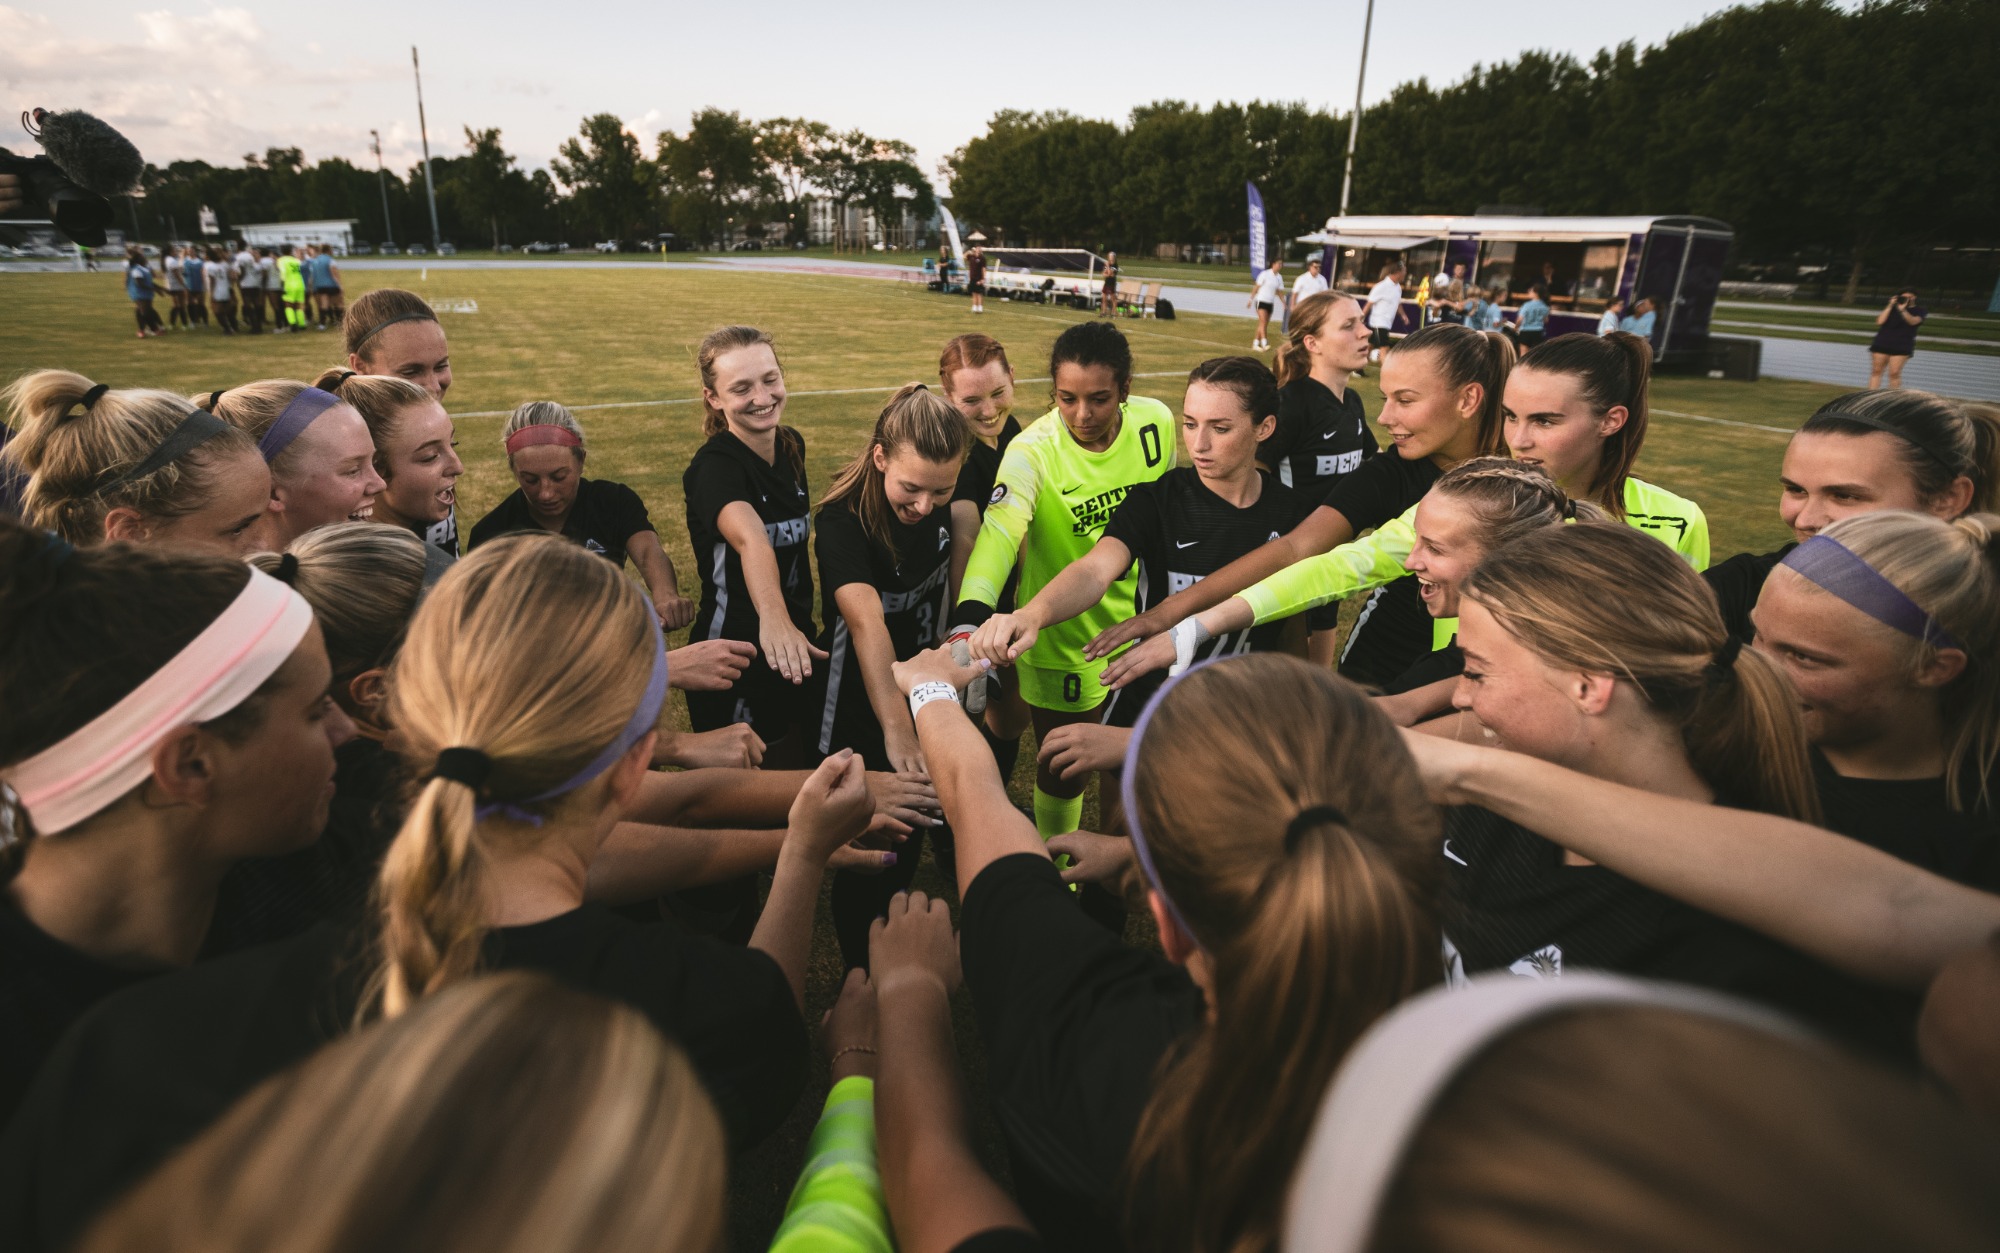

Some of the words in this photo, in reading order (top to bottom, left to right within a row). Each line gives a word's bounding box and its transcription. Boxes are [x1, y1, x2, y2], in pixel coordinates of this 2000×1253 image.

[1139, 423, 1162, 468] 0
[1316, 449, 1363, 476] BEA
[916, 602, 932, 646] 3
[1064, 673, 1081, 702] 0
